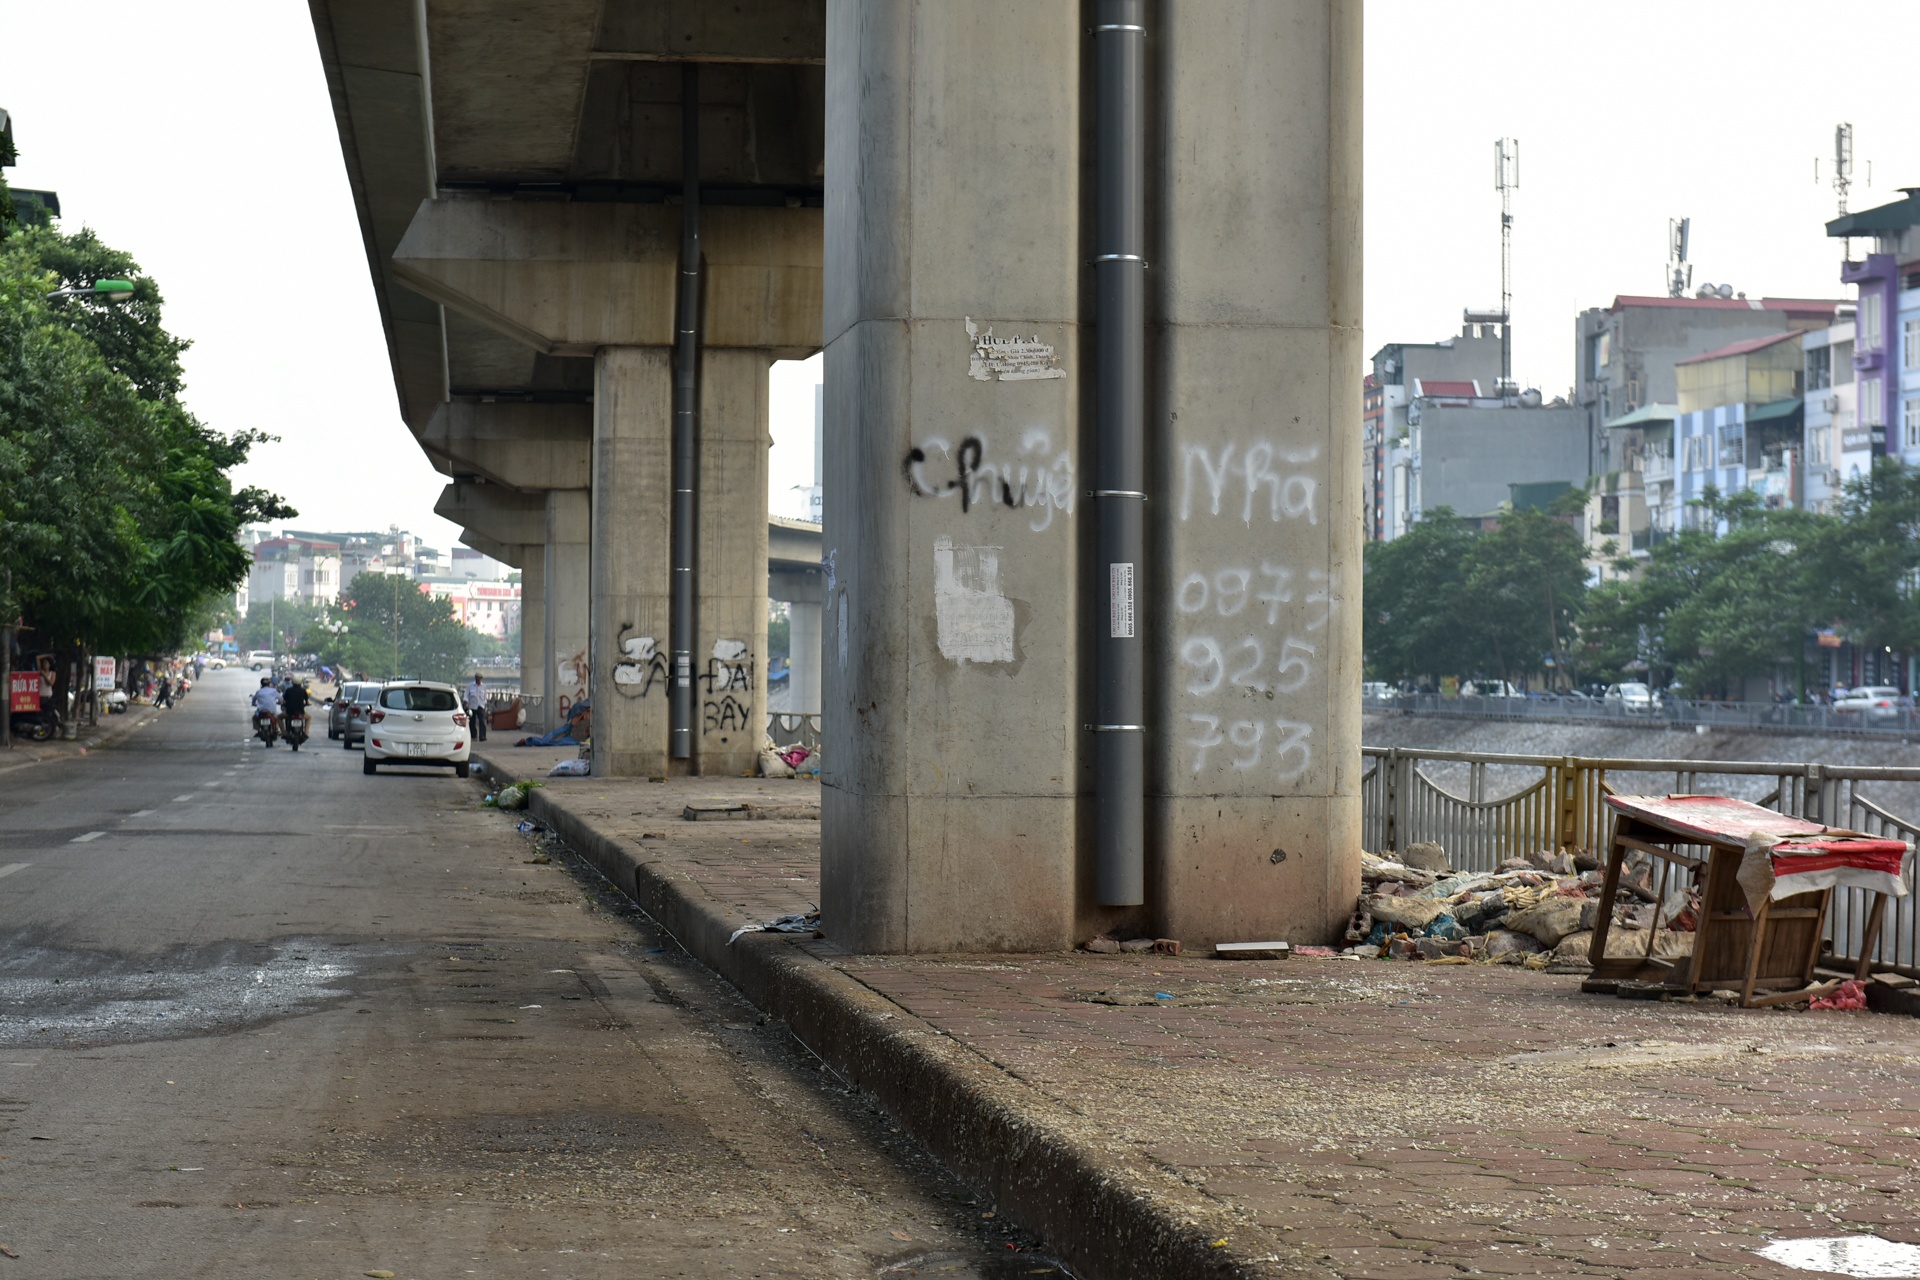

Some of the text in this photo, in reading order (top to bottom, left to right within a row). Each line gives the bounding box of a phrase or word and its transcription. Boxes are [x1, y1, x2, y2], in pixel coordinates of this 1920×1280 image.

[1177, 563, 1336, 631] 0973
[28, 678, 39, 693] XE
[1180, 637, 1316, 696] 925
[1185, 713, 1311, 779] 793
